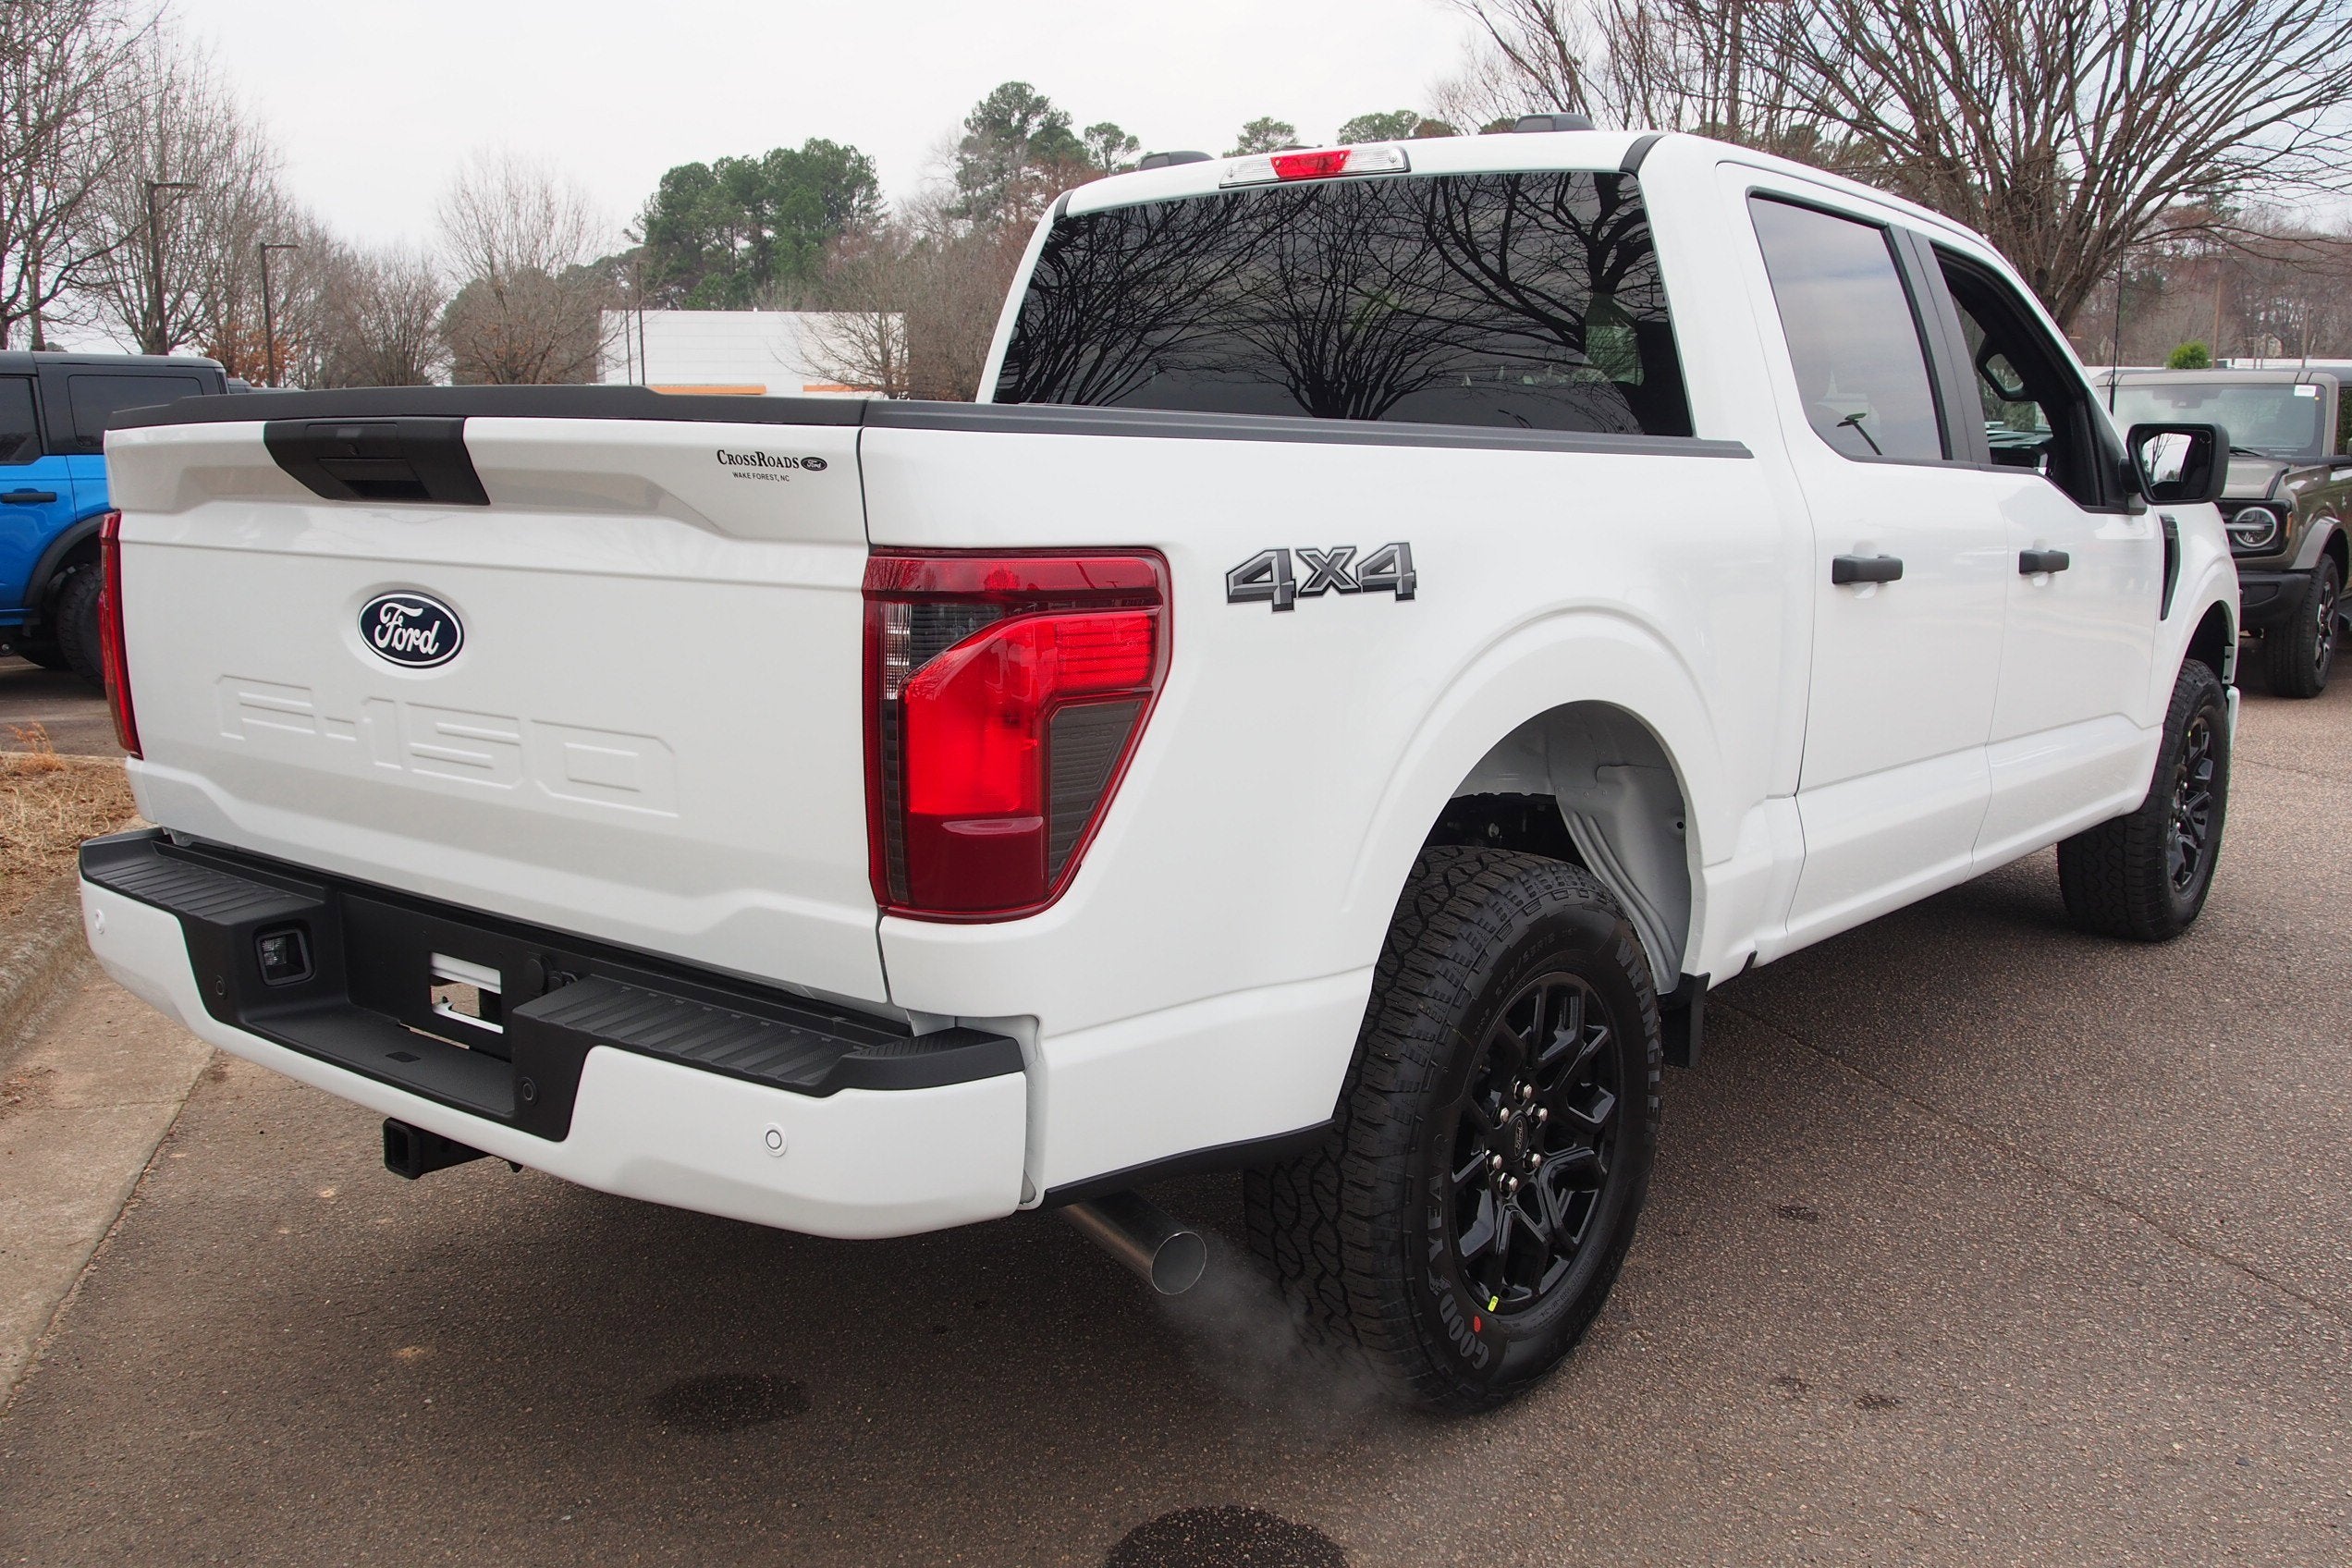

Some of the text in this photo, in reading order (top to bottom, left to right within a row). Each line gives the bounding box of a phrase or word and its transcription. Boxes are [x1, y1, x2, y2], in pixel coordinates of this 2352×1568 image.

[732, 472, 752, 480] WAKE
[753, 473, 780, 482] FOREST,
[374, 602, 441, 655] Ford
[215, 674, 679, 817] F-150
